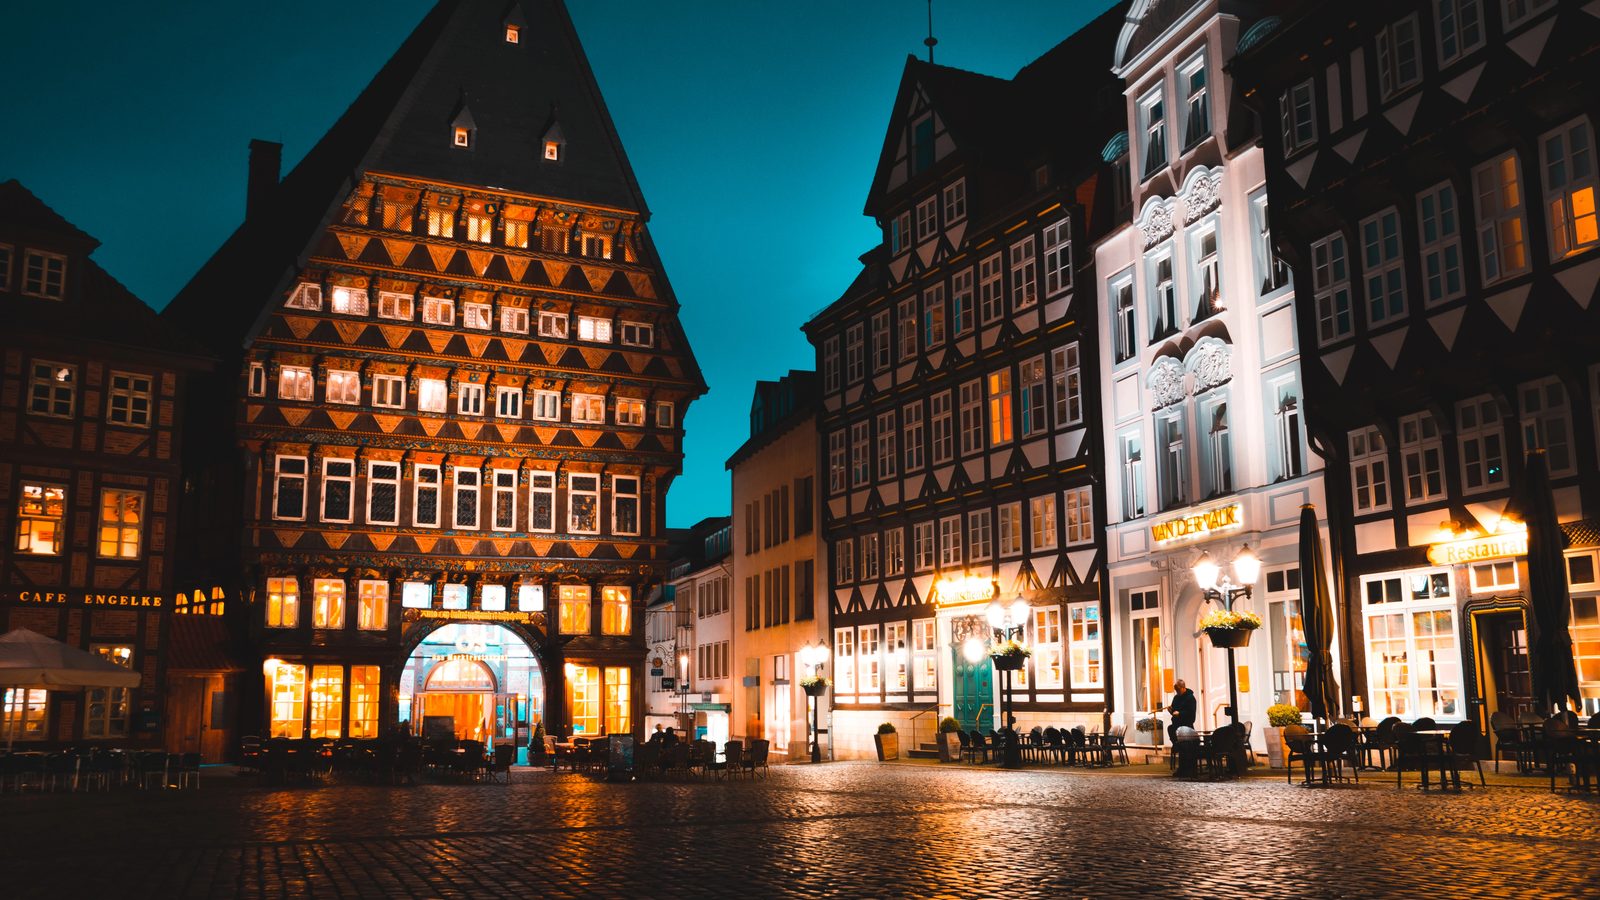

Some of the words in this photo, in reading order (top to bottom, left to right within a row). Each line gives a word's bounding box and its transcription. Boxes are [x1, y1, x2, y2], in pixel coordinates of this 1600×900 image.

[1151, 521, 1174, 541] VAN
[1177, 515, 1203, 537] DER
[1203, 505, 1239, 530] VALK
[19, 591, 67, 603] CAFE
[84, 594, 162, 607] ENGELKE
